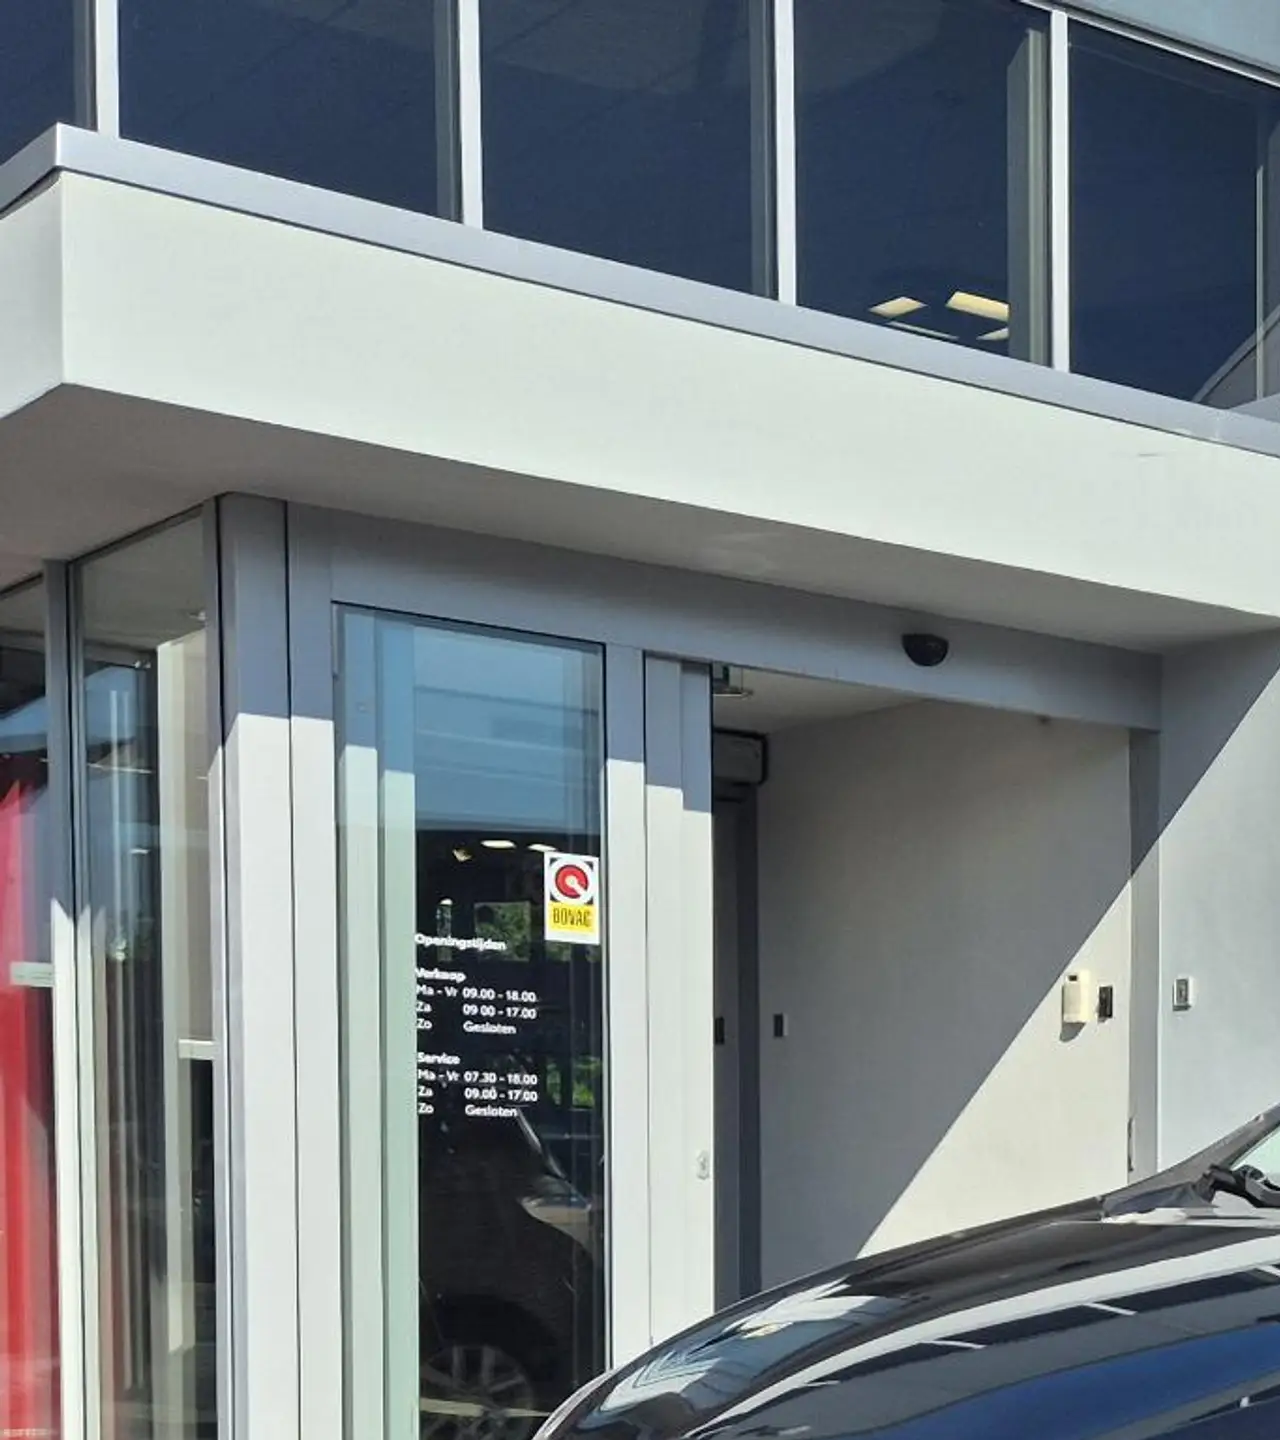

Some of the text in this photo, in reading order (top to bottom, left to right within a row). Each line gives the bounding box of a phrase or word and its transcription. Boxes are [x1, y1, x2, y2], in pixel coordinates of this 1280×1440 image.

[552, 906, 594, 928] BOVAG
[415, 933, 507, 951] Openingstijden
[415, 967, 466, 983] Verkoop
[416, 984, 435, 997] Ma
[444, 986, 459, 998] Vr
[462, 987, 496, 1000] 09.00
[505, 990, 538, 1003] 18.00
[416, 1001, 432, 1013] Za
[506, 1007, 537, 1020] 17.00
[417, 1018, 517, 1035] Zo Gesloten
[417, 1052, 460, 1065] Service
[418, 1068, 436, 1082] Ma
[446, 1069, 460, 1082] Vr
[463, 1070, 497, 1084] 07.30
[506, 1073, 538, 1086] 18.00
[418, 1085, 434, 1098] Za
[464, 1086, 498, 1100] 09.00
[507, 1089, 538, 1102] 17.00
[418, 1102, 519, 1117] Zo Gesloten
